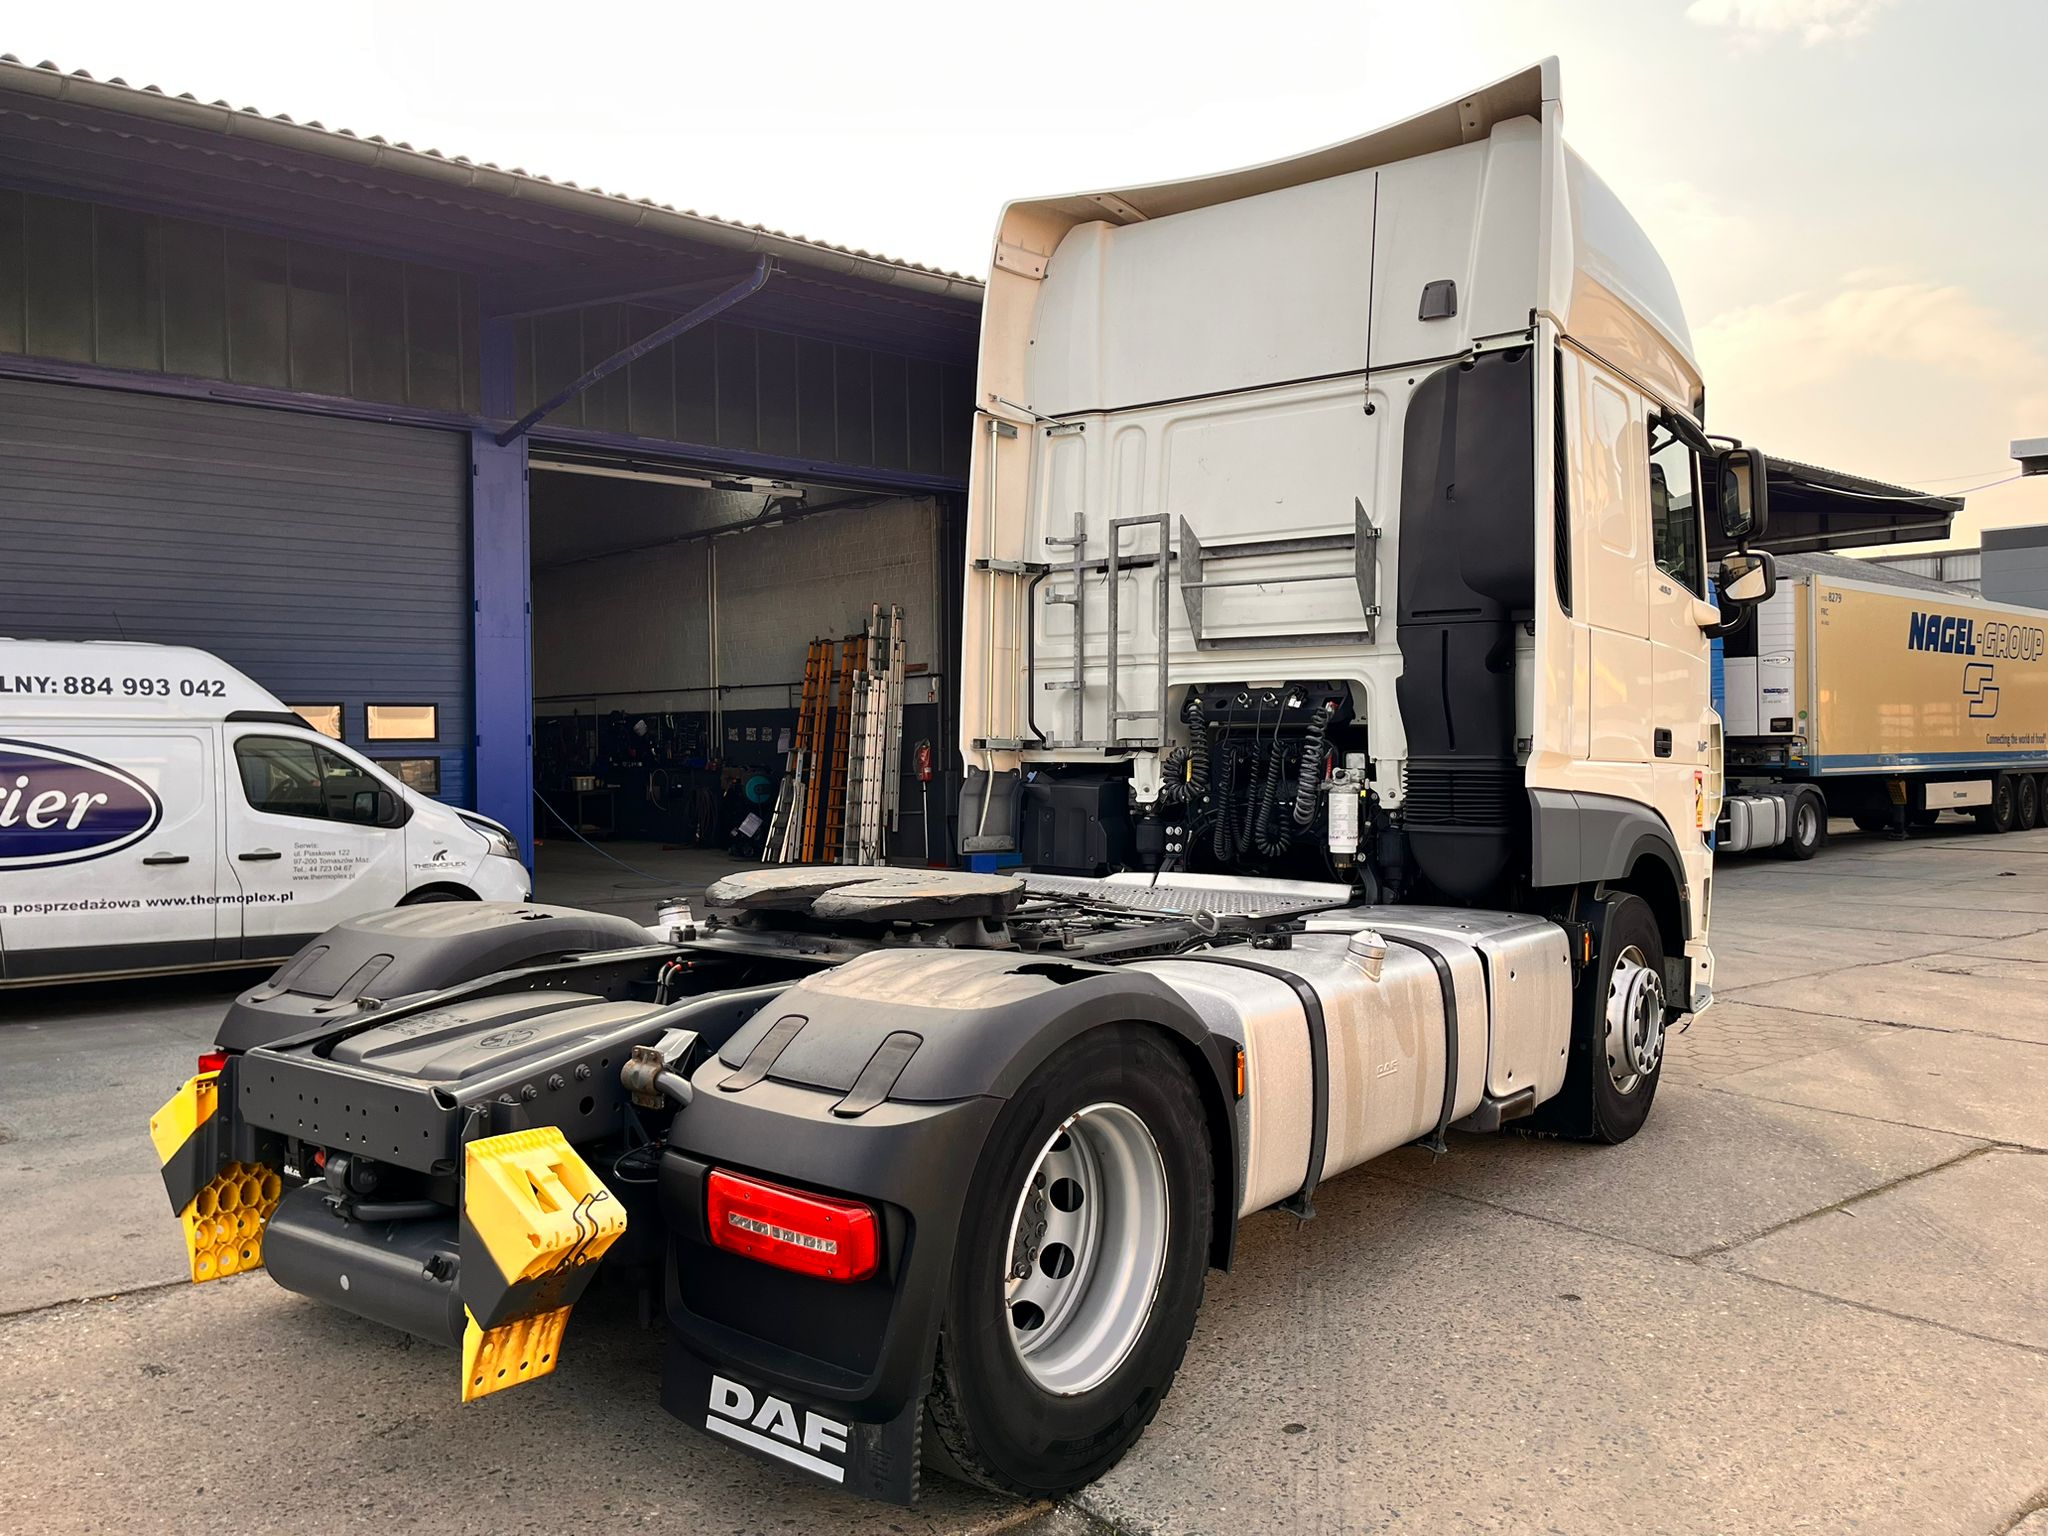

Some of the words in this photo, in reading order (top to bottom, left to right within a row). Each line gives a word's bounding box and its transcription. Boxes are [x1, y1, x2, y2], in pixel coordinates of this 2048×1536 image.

[1908, 611, 2045, 662] NAGEL-GROUP
[63, 676, 114, 695] 884
[122, 678, 171, 696] 993
[180, 679, 226, 697] 042
[1986, 733, 2010, 747] Connecting
[13, 899, 140, 915] posprzedażowa
[146, 891, 293, 907] www.thermoplex.pl
[709, 1375, 848, 1453] DAF
